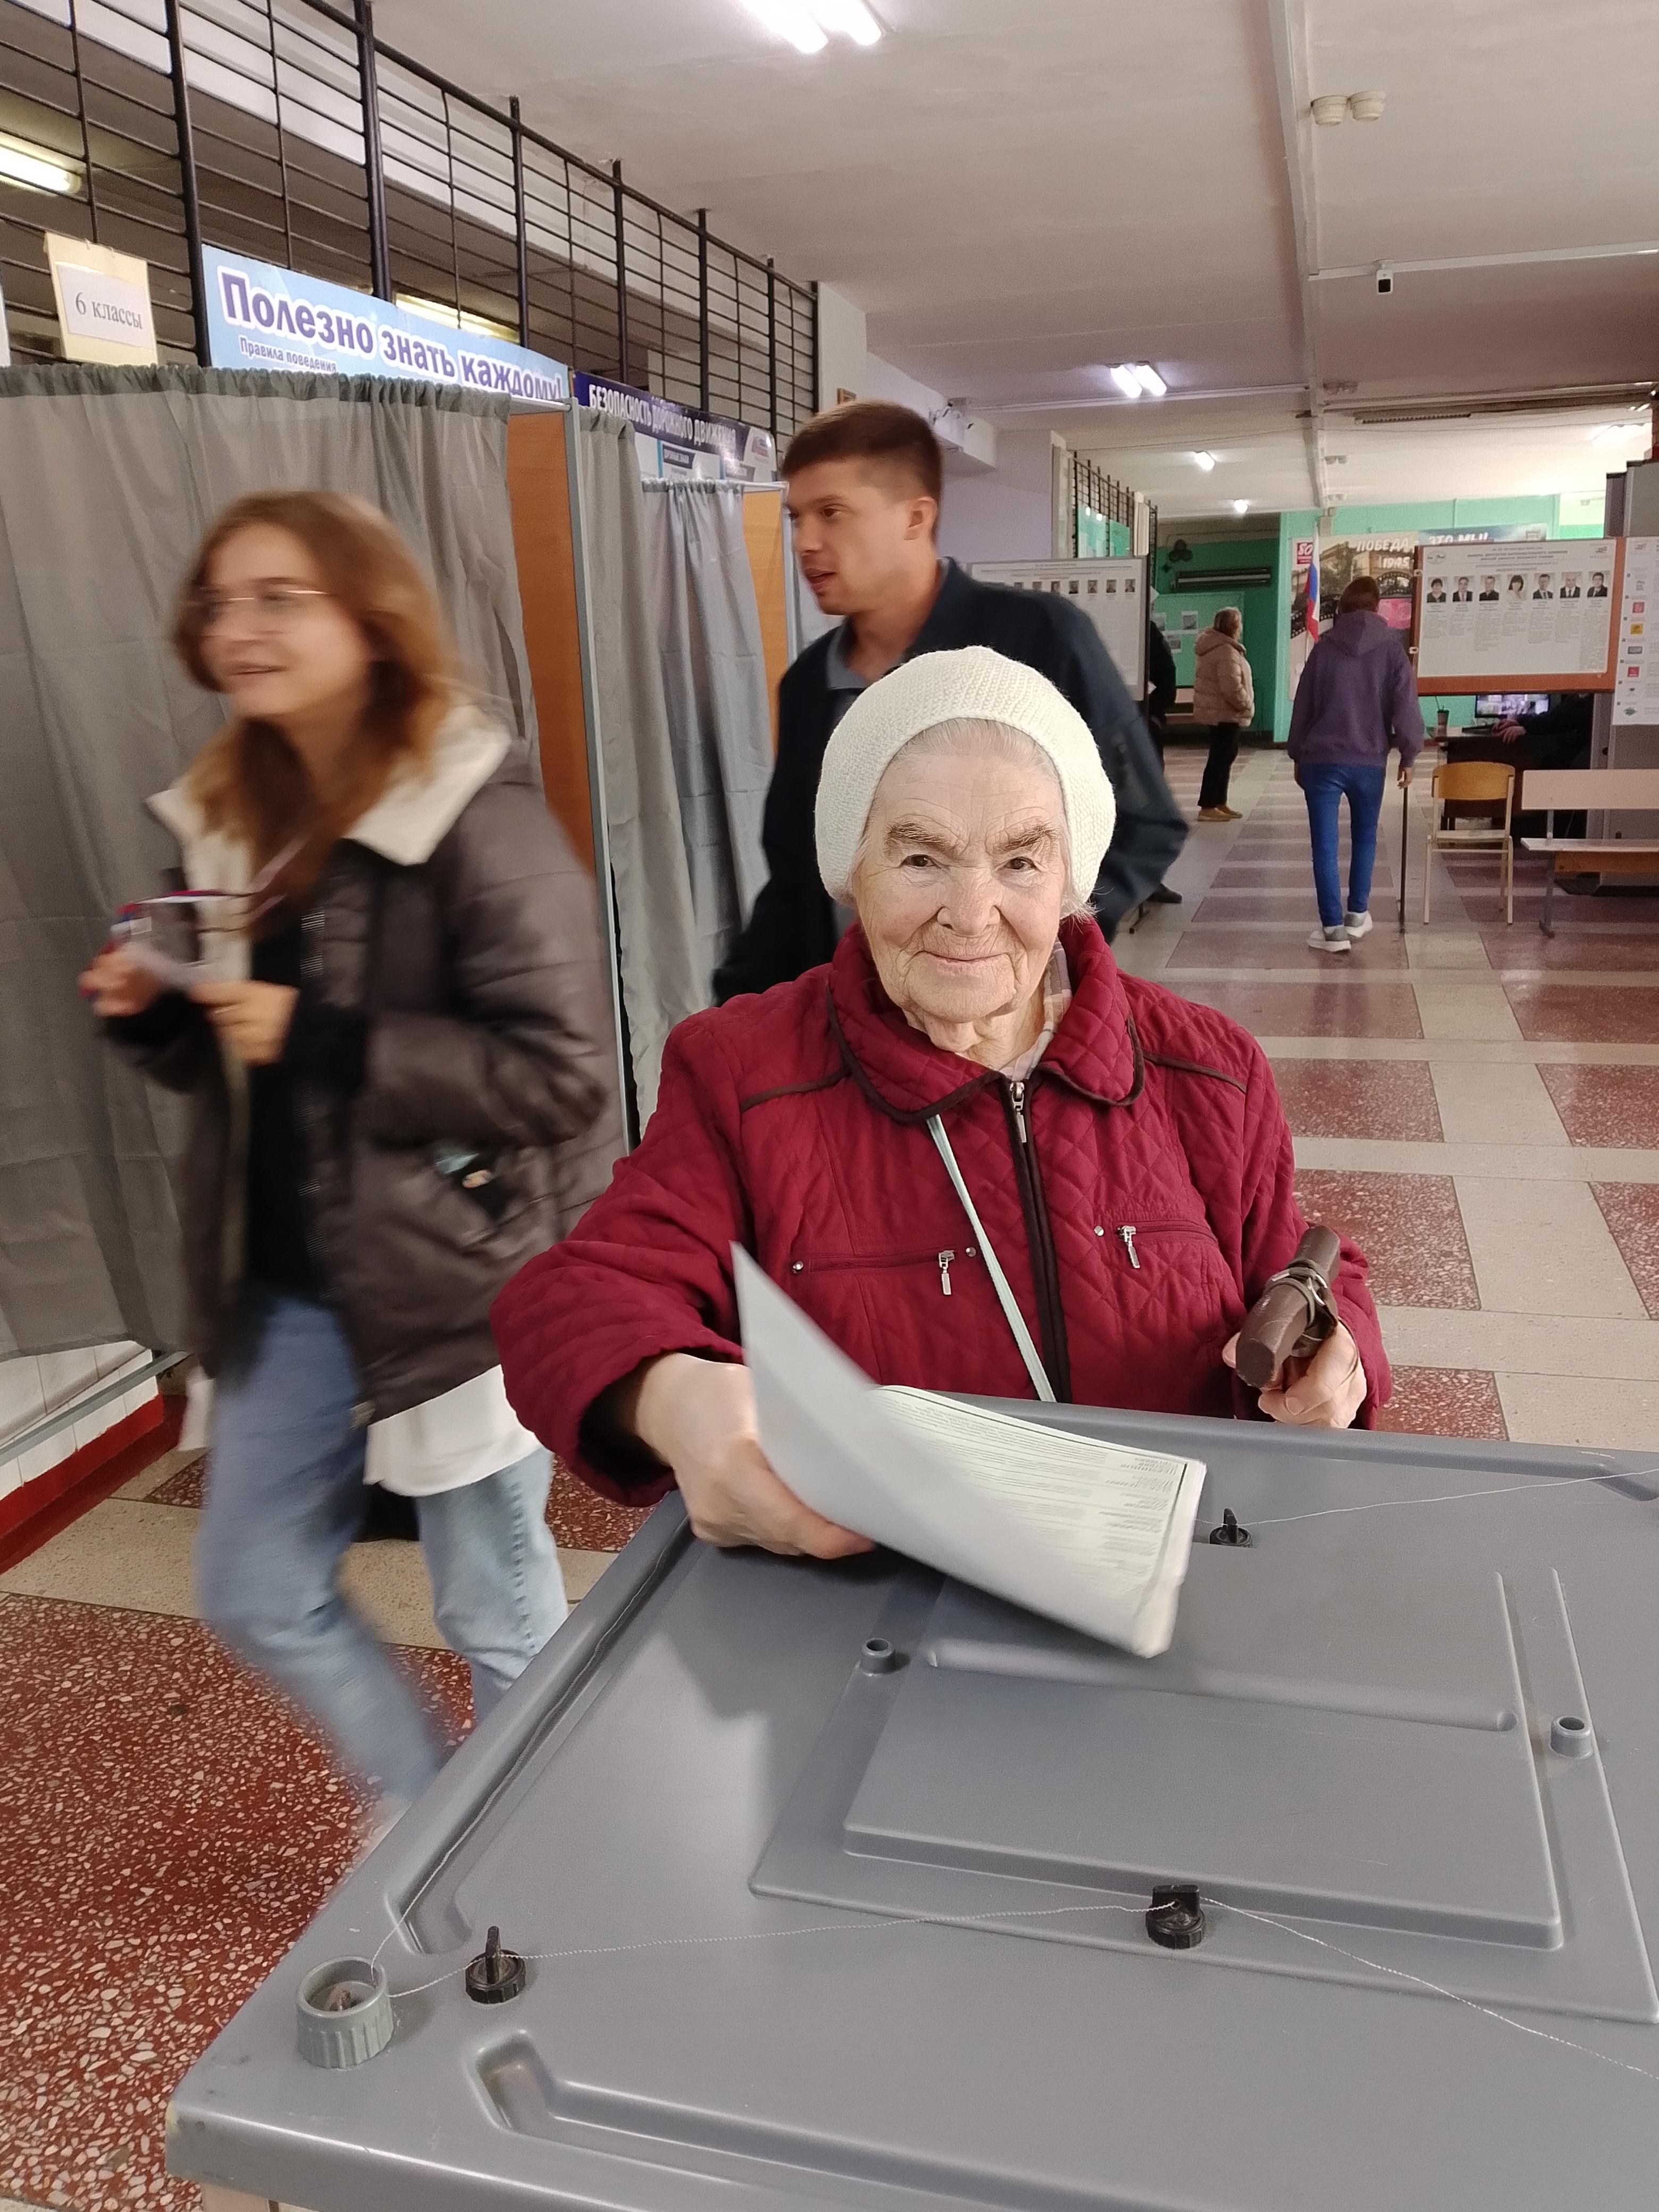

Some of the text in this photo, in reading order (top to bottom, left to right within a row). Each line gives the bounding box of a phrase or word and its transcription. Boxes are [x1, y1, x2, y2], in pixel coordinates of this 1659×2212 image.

[76, 292, 143, 329] 6 классы
[221, 272, 562, 402] Полезно знать каждому!
[240, 337, 337, 372] Правила поведения
[589, 383, 652, 427] БЕЗОПАСНОСТЬ
